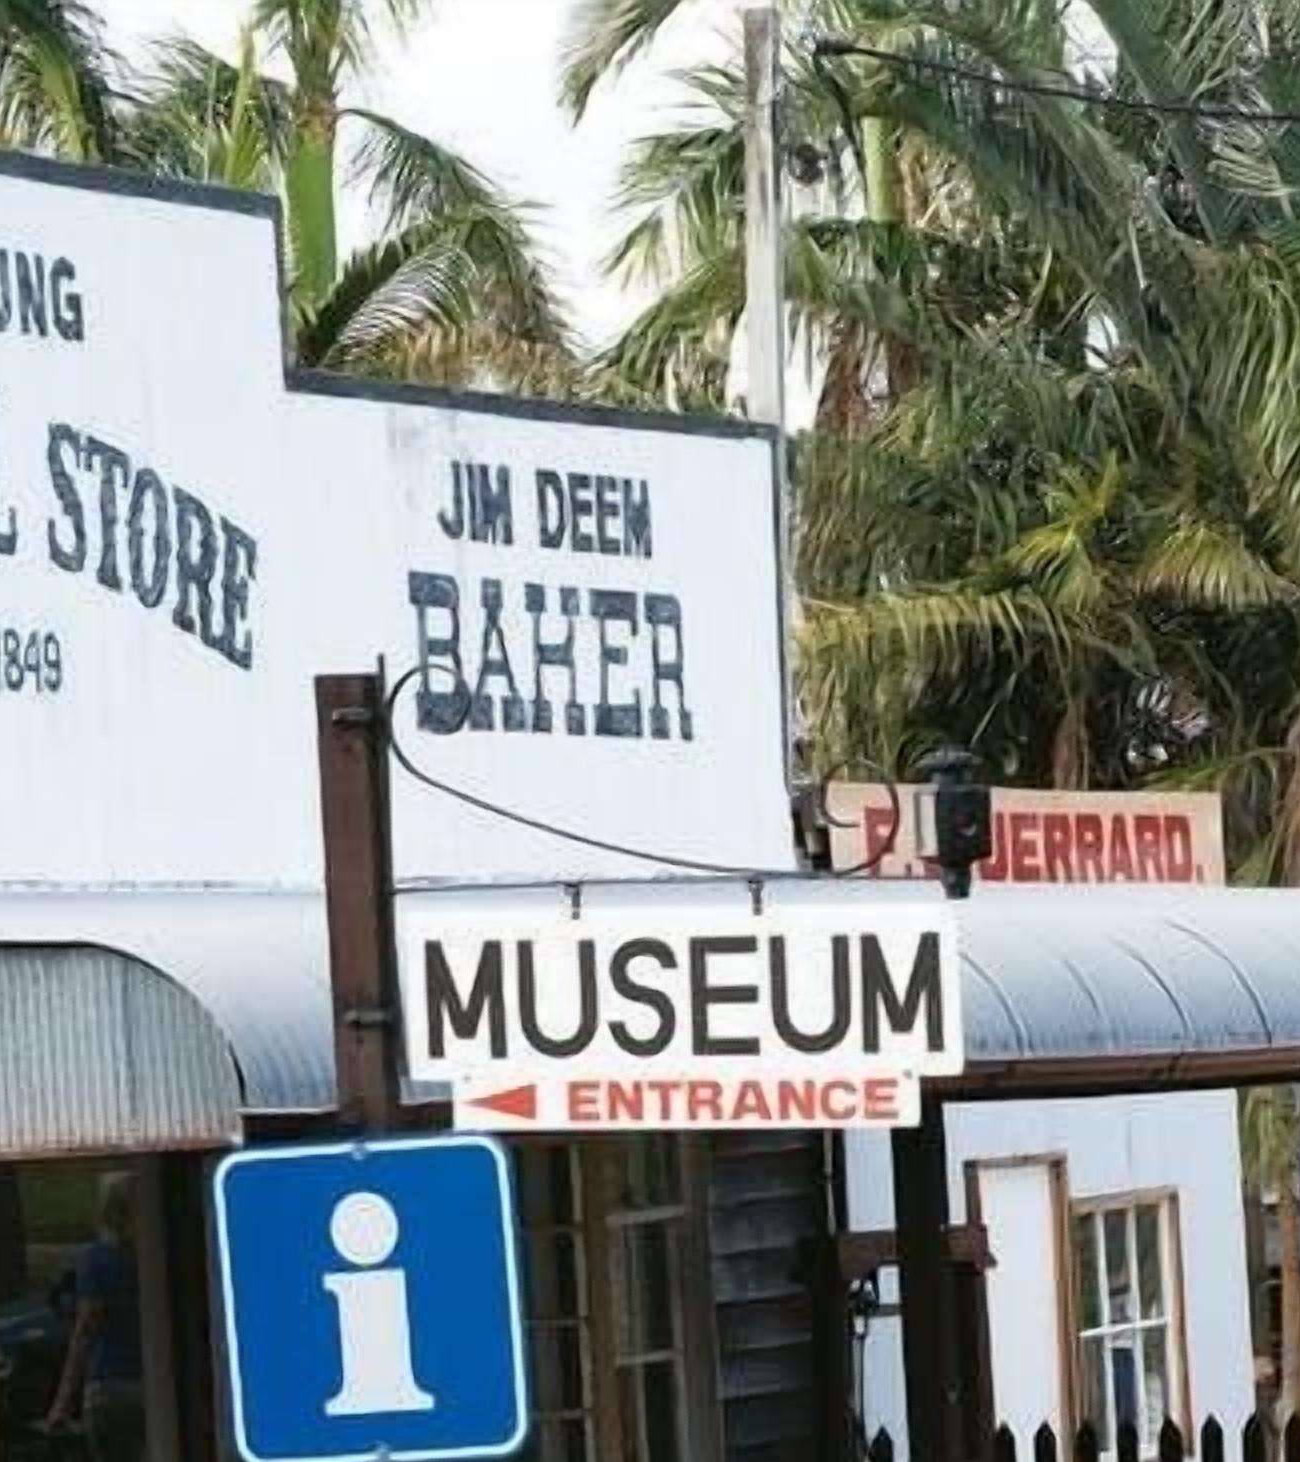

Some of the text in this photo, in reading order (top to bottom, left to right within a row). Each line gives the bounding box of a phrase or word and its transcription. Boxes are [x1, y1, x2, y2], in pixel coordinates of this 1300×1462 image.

[46, 422, 258, 671] STORE
[437, 460, 653, 560] JIM DEEM
[424, 931, 945, 1060] MUSEUM
[567, 1079, 899, 1121] ENTRANCE
